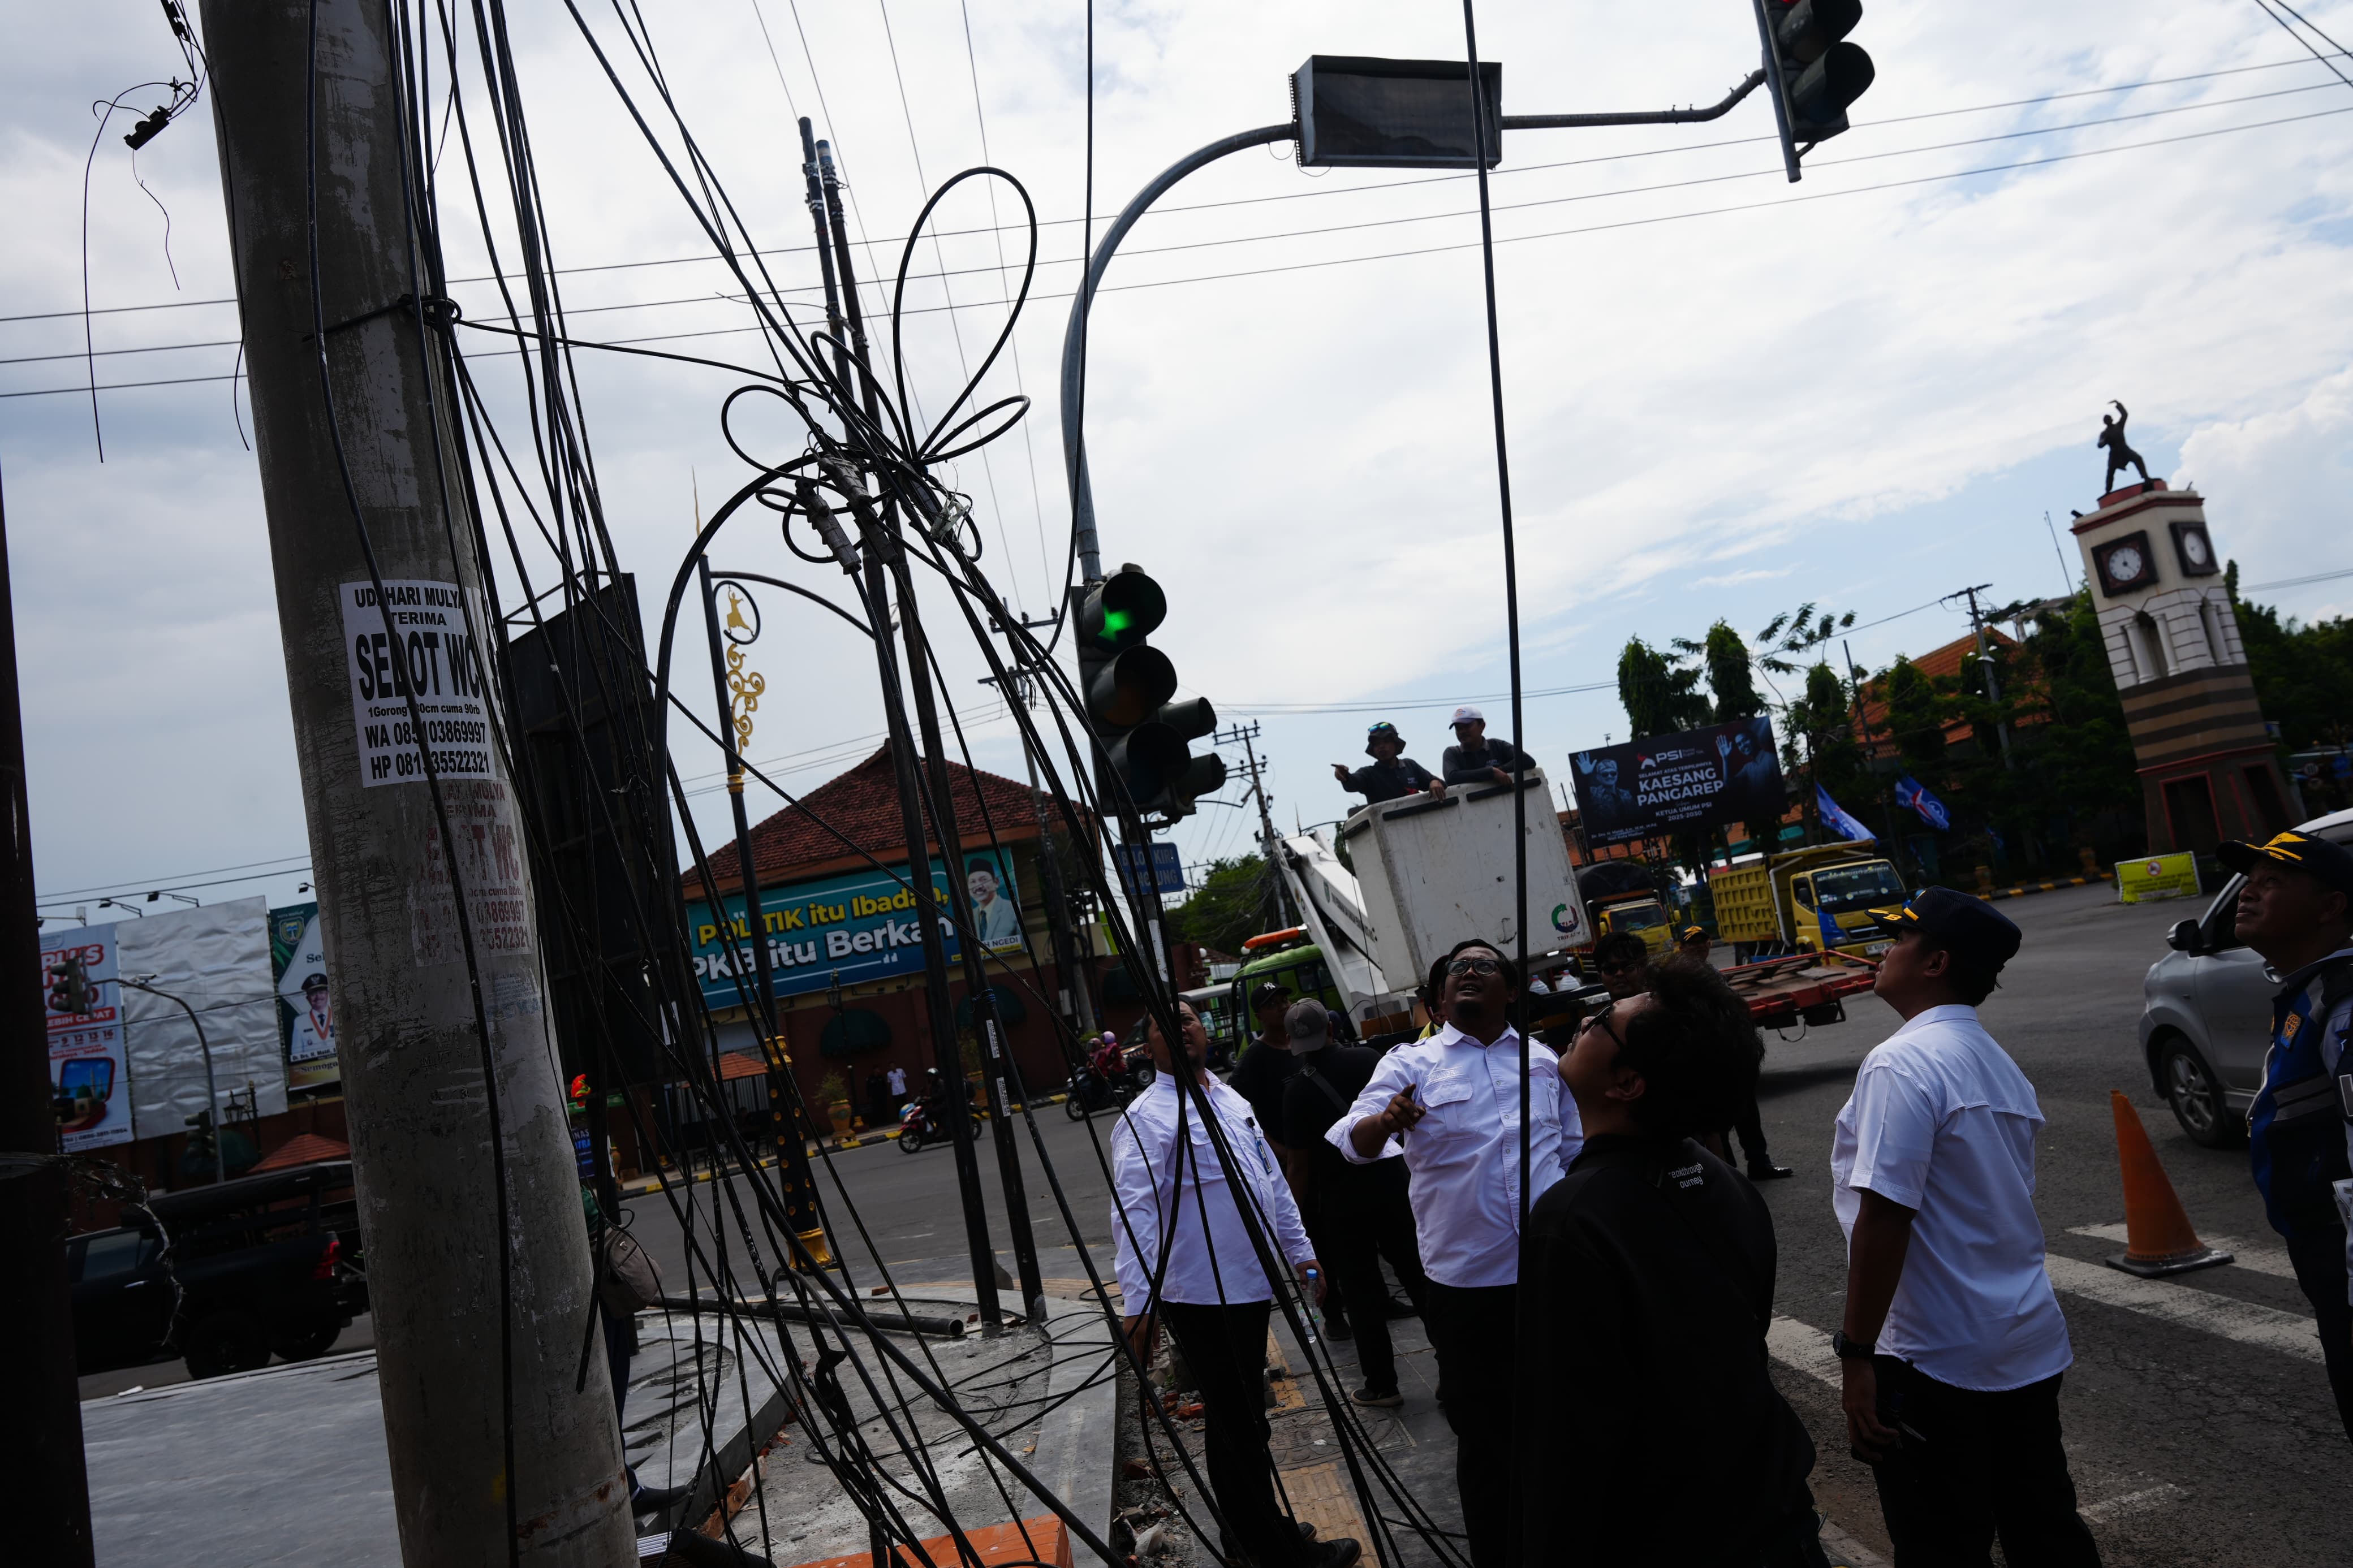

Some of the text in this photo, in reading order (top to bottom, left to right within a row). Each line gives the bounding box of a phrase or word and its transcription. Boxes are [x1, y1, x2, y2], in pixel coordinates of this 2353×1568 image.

[385, 587, 421, 606] HARI
[390, 612, 447, 625] TERIMA
[445, 632, 480, 699] WC
[441, 705, 463, 714] cuma
[464, 703, 480, 715] 90rb
[365, 724, 391, 748] WA
[370, 750, 490, 779] HP 08135522321
[1656, 749, 1683, 763] PSI
[1639, 767, 1717, 792] KAESANG
[1637, 780, 1724, 806] PANGAREP
[1656, 809, 1678, 817] KETUA
[1679, 804, 1701, 813] UMUM
[1668, 810, 1703, 821] 2025-2030
[1121, 848, 1175, 866] BLO KIRI
[488, 887, 507, 896] cuma
[699, 907, 805, 945] POLTIK
[809, 902, 846, 926] itu
[992, 936, 1019, 947] NGEDI
[767, 938, 818, 969] itu
